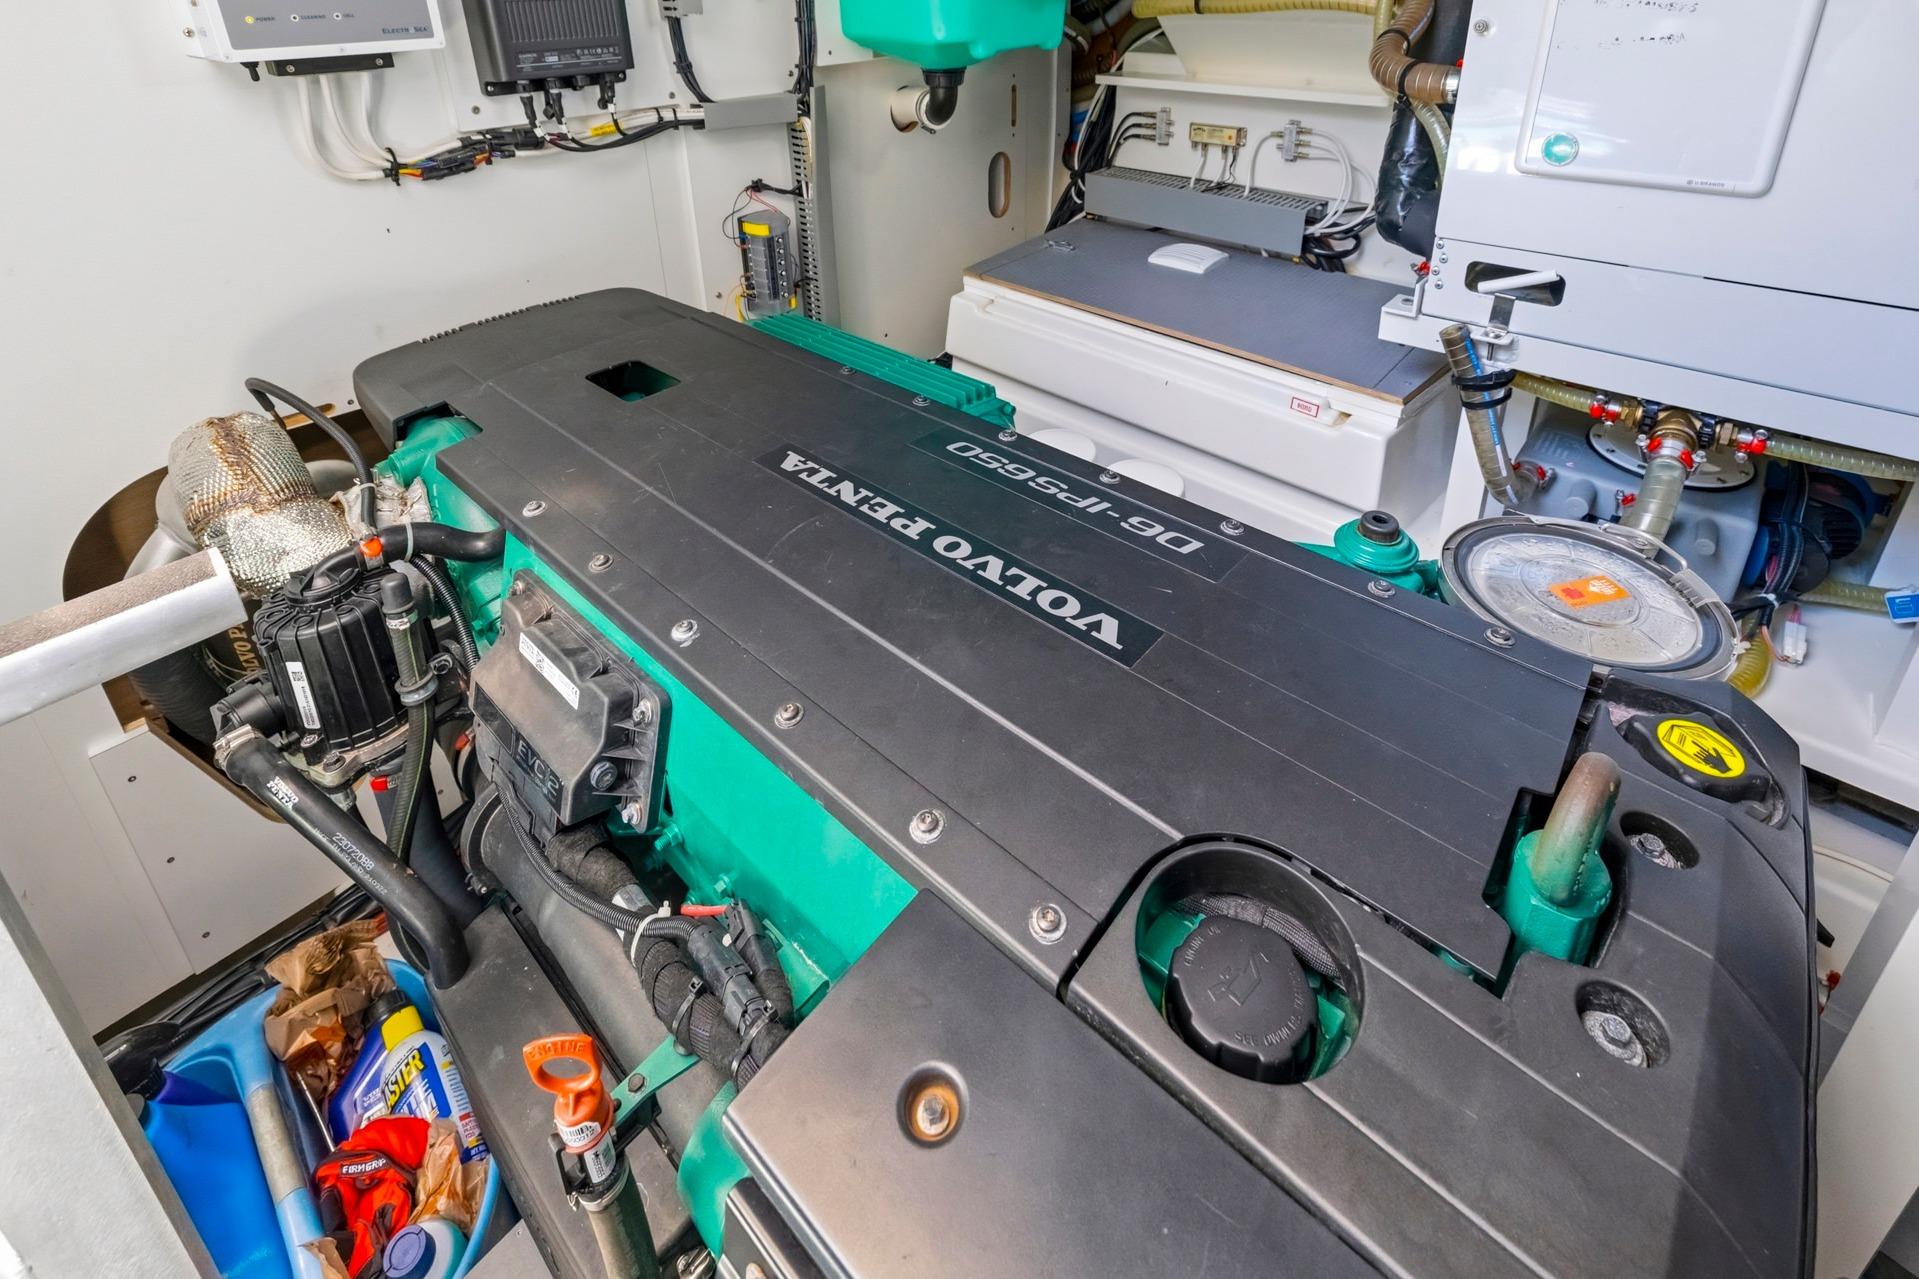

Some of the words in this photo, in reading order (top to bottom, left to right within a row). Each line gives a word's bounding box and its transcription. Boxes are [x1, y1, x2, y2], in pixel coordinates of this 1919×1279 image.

[780, 450, 936, 540] PENTA
[946, 442, 1205, 554] D6-IPS650
[932, 535, 1124, 650] VOLVO
[529, 1041, 585, 1059] ENGINE
